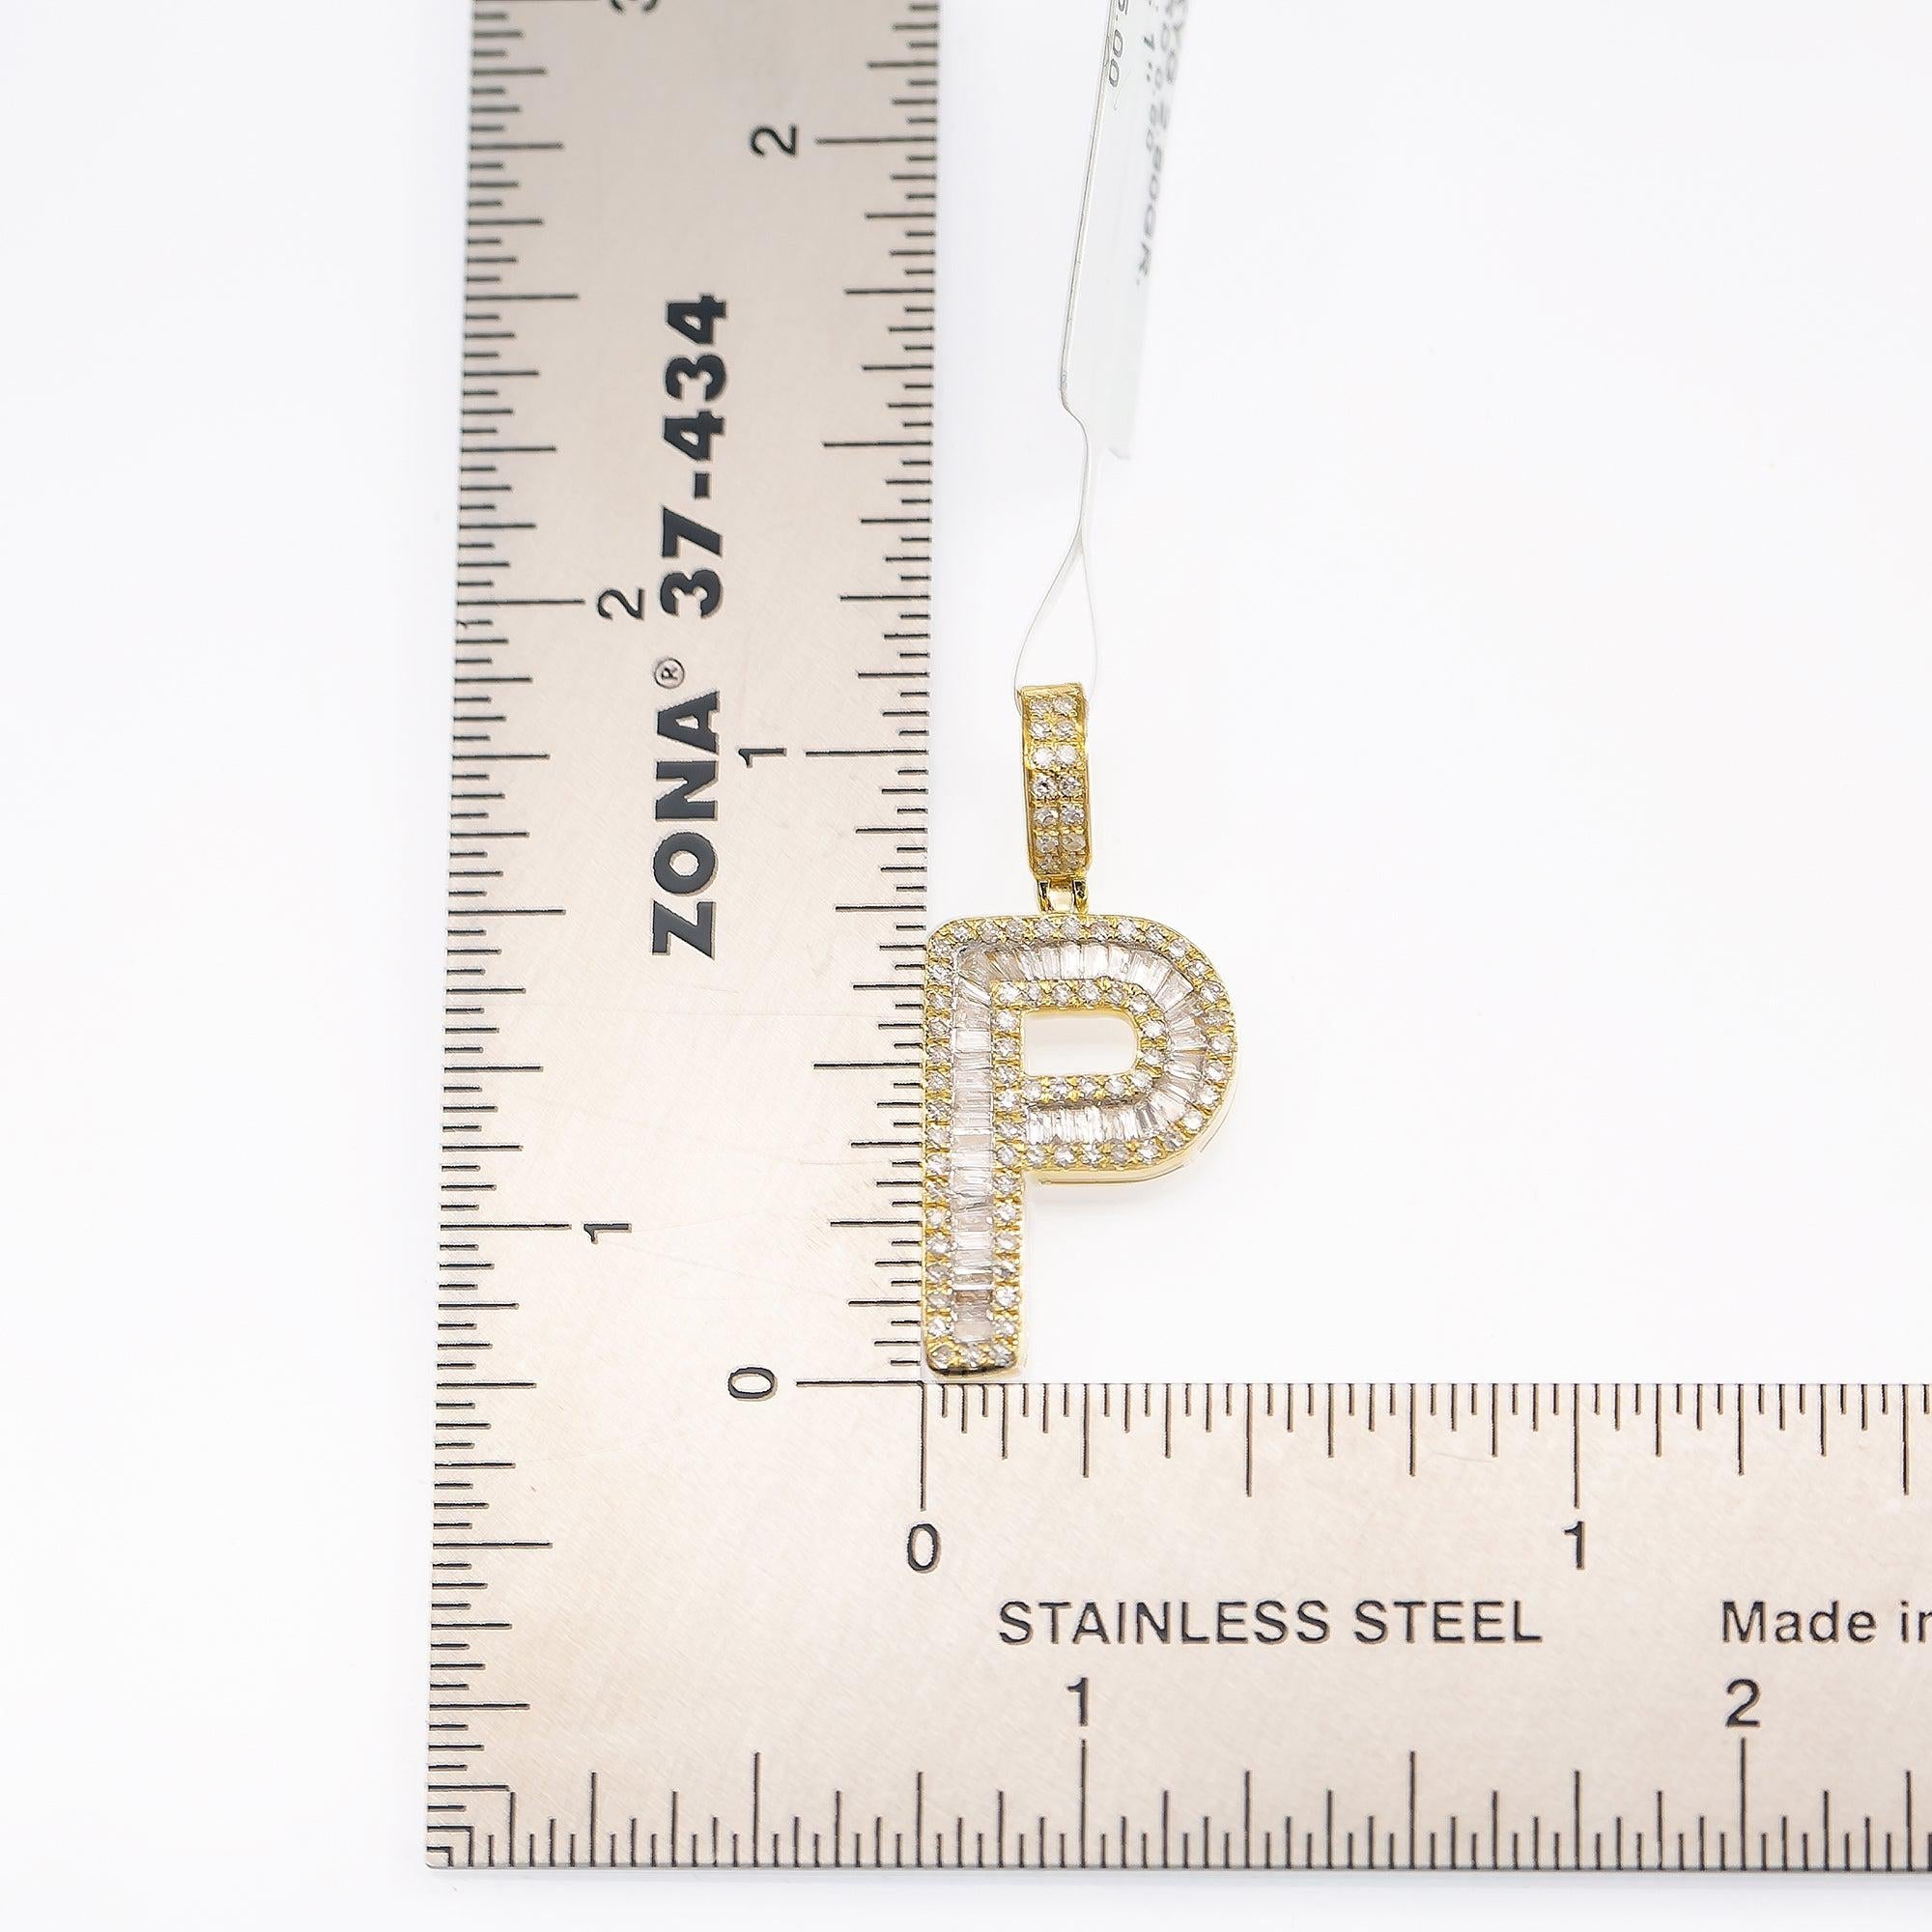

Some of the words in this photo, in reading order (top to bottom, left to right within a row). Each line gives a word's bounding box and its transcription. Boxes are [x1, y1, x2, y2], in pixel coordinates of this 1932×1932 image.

[749, 125, 799, 157] 2
[660, 293, 727, 618] 37-434
[595, 587, 645, 621] 2
[738, 747, 788, 768] 1
[582, 1220, 634, 1244] 1
[727, 1366, 778, 1403] 0
[906, 1522, 943, 1575] 0
[1563, 1520, 1586, 1572] 1
[998, 1599, 1332, 1646] STAINLESS
[1352, 1599, 1544, 1645] STEEL
[1721, 1599, 1877, 1644] Made
[1066, 1676, 1091, 1727] 1
[1724, 1677, 1762, 1728] 2
